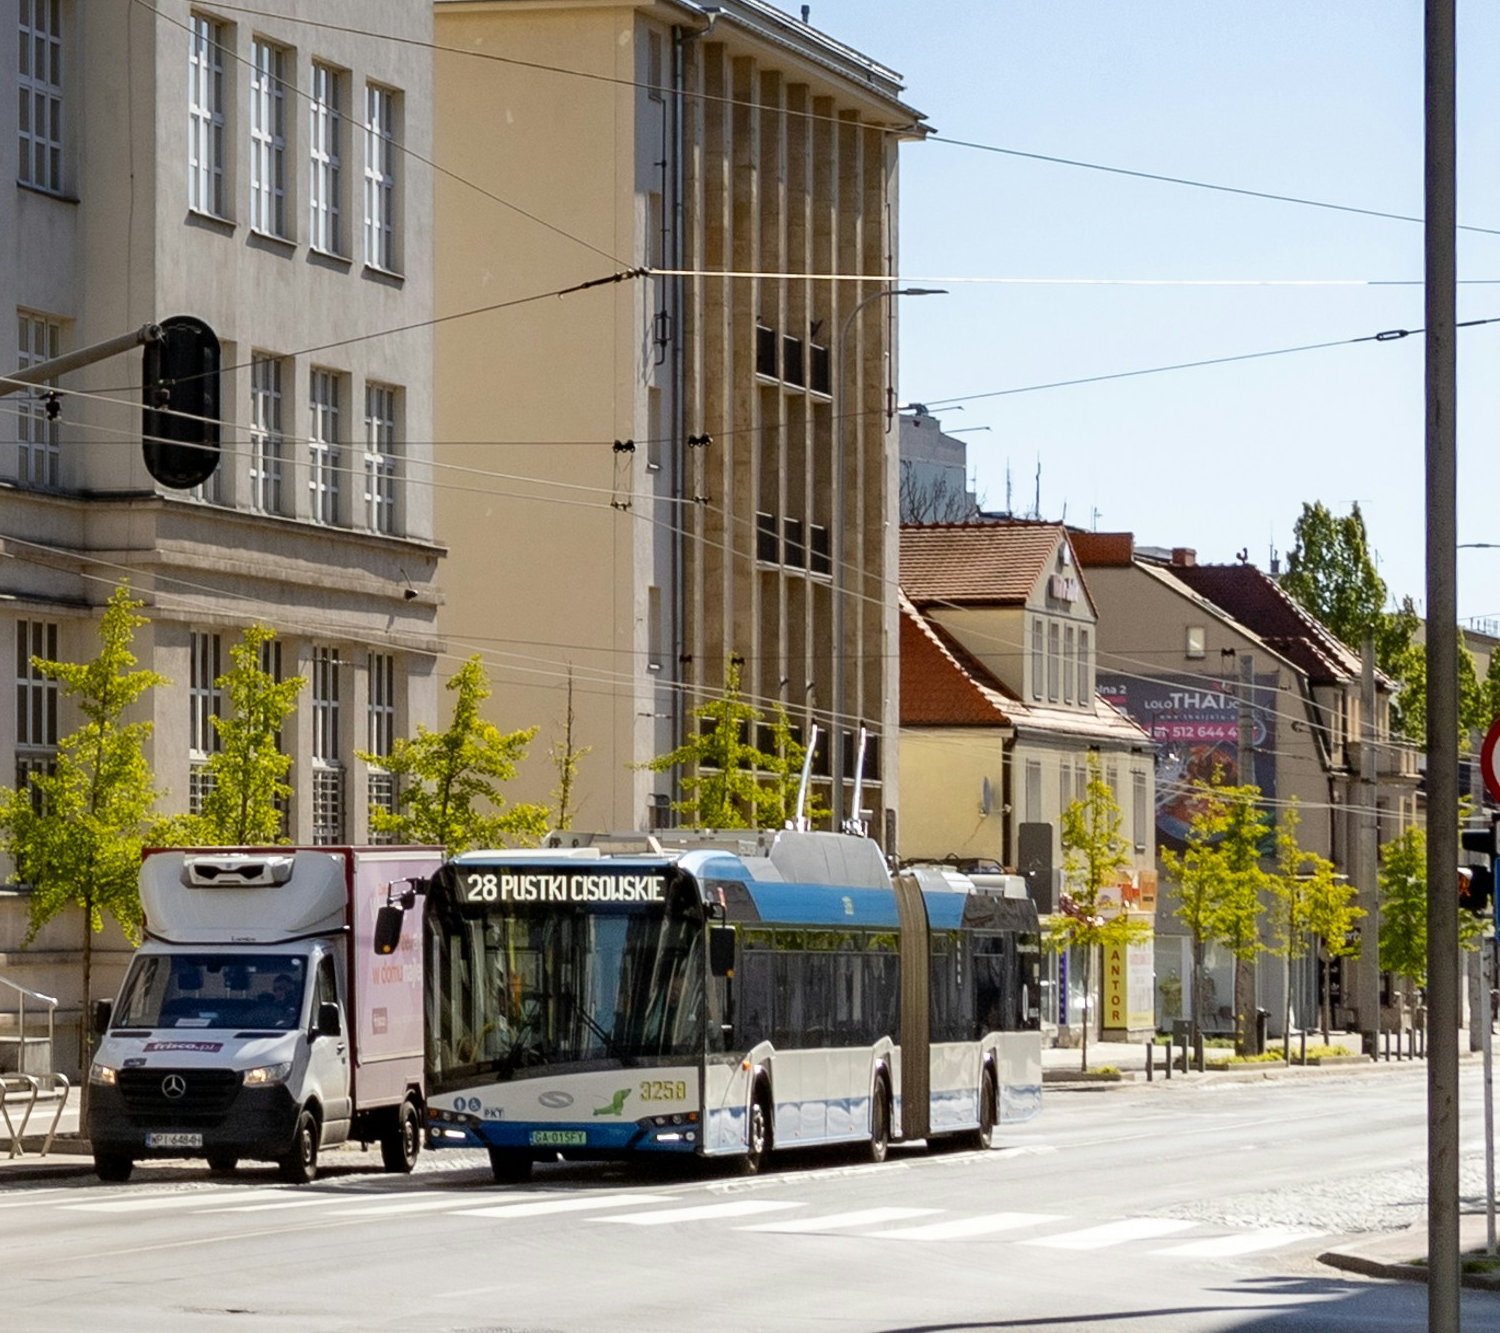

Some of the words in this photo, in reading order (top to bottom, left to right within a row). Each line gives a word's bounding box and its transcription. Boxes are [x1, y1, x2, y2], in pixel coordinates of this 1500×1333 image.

[1119, 685, 1127, 694] 2
[1172, 726, 1194, 737] 512
[1197, 726, 1225, 737] 644
[467, 873, 498, 901] 28
[501, 874, 567, 901] PUSTKI
[570, 875, 665, 902] CISOWSKIE
[153, 1042, 215, 1051] frisco.pl
